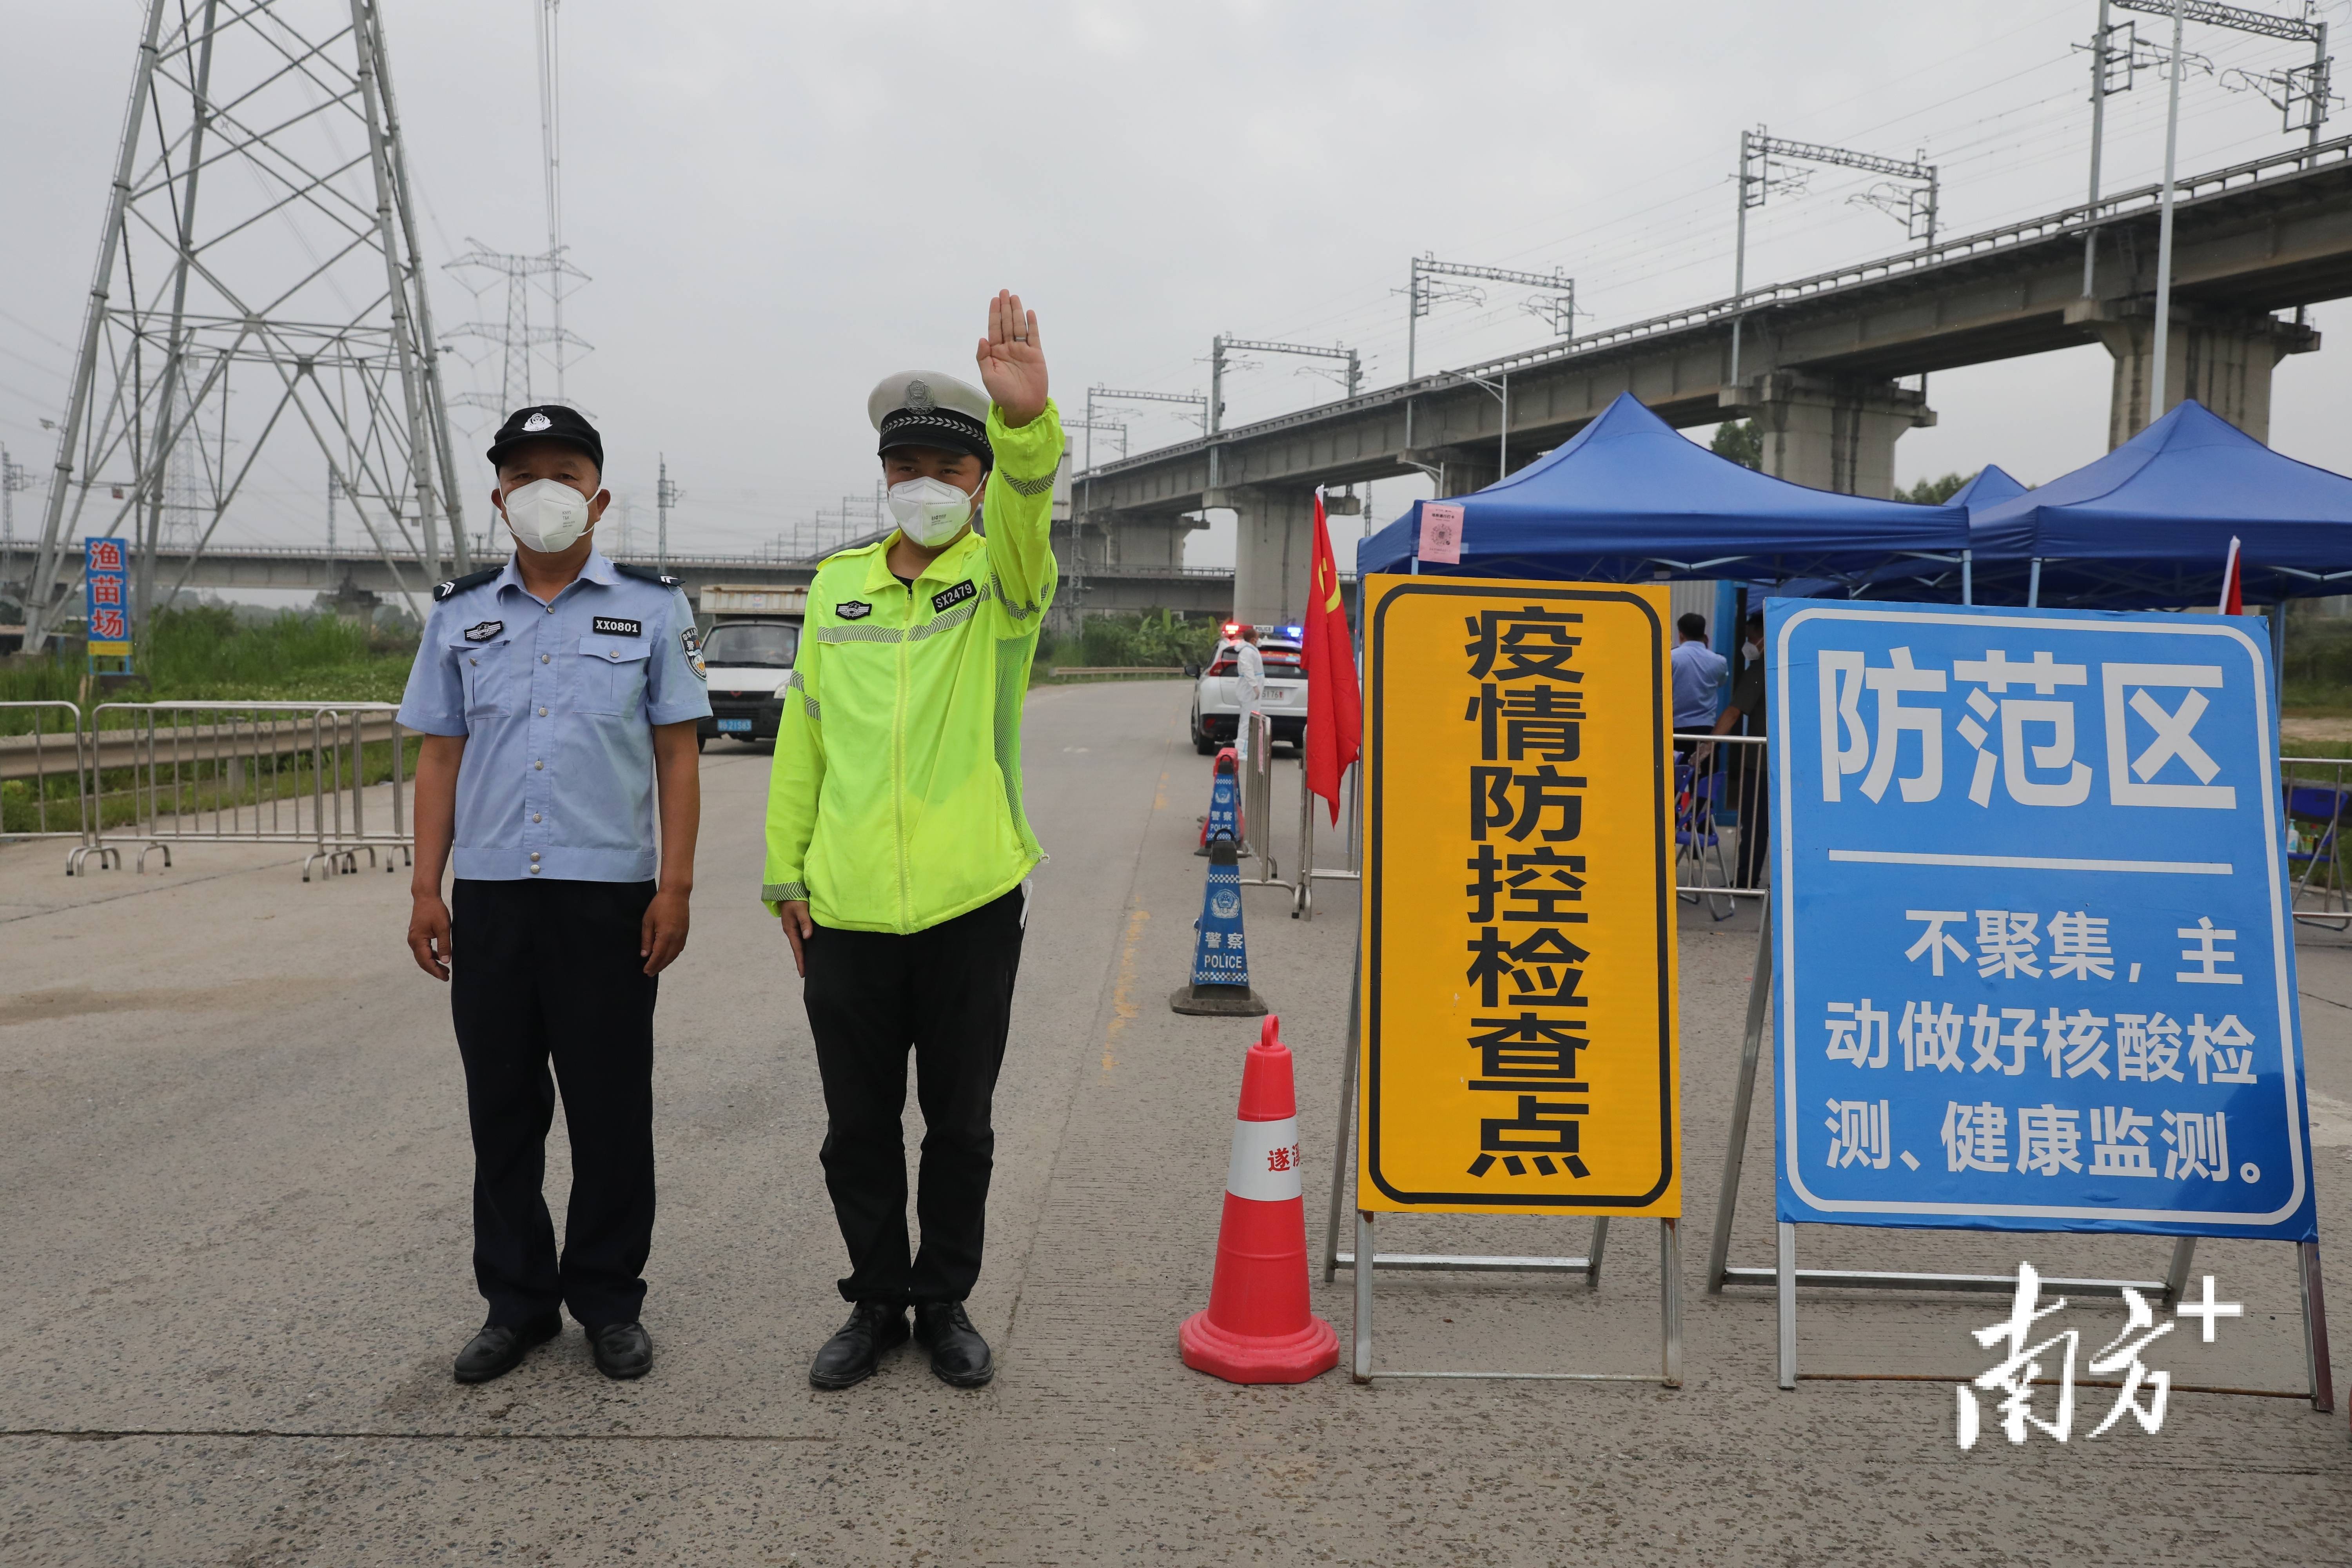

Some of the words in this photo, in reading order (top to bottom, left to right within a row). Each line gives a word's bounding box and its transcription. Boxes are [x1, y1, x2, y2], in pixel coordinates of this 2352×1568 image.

[90, 541, 124, 639] 渔苗场
[596, 620, 638, 632] XX0801
[936, 584, 972, 608] SX2479
[1818, 646, 2237, 809] 防范区
[1465, 606, 1591, 1178] 疫情防控检查点
[1204, 955, 1242, 968] POLICE
[1205, 931, 1243, 949] 警察
[1825, 998, 2257, 1084] 动做好核酸检
[1825, 1098, 2261, 1184] 测、健康监测。
